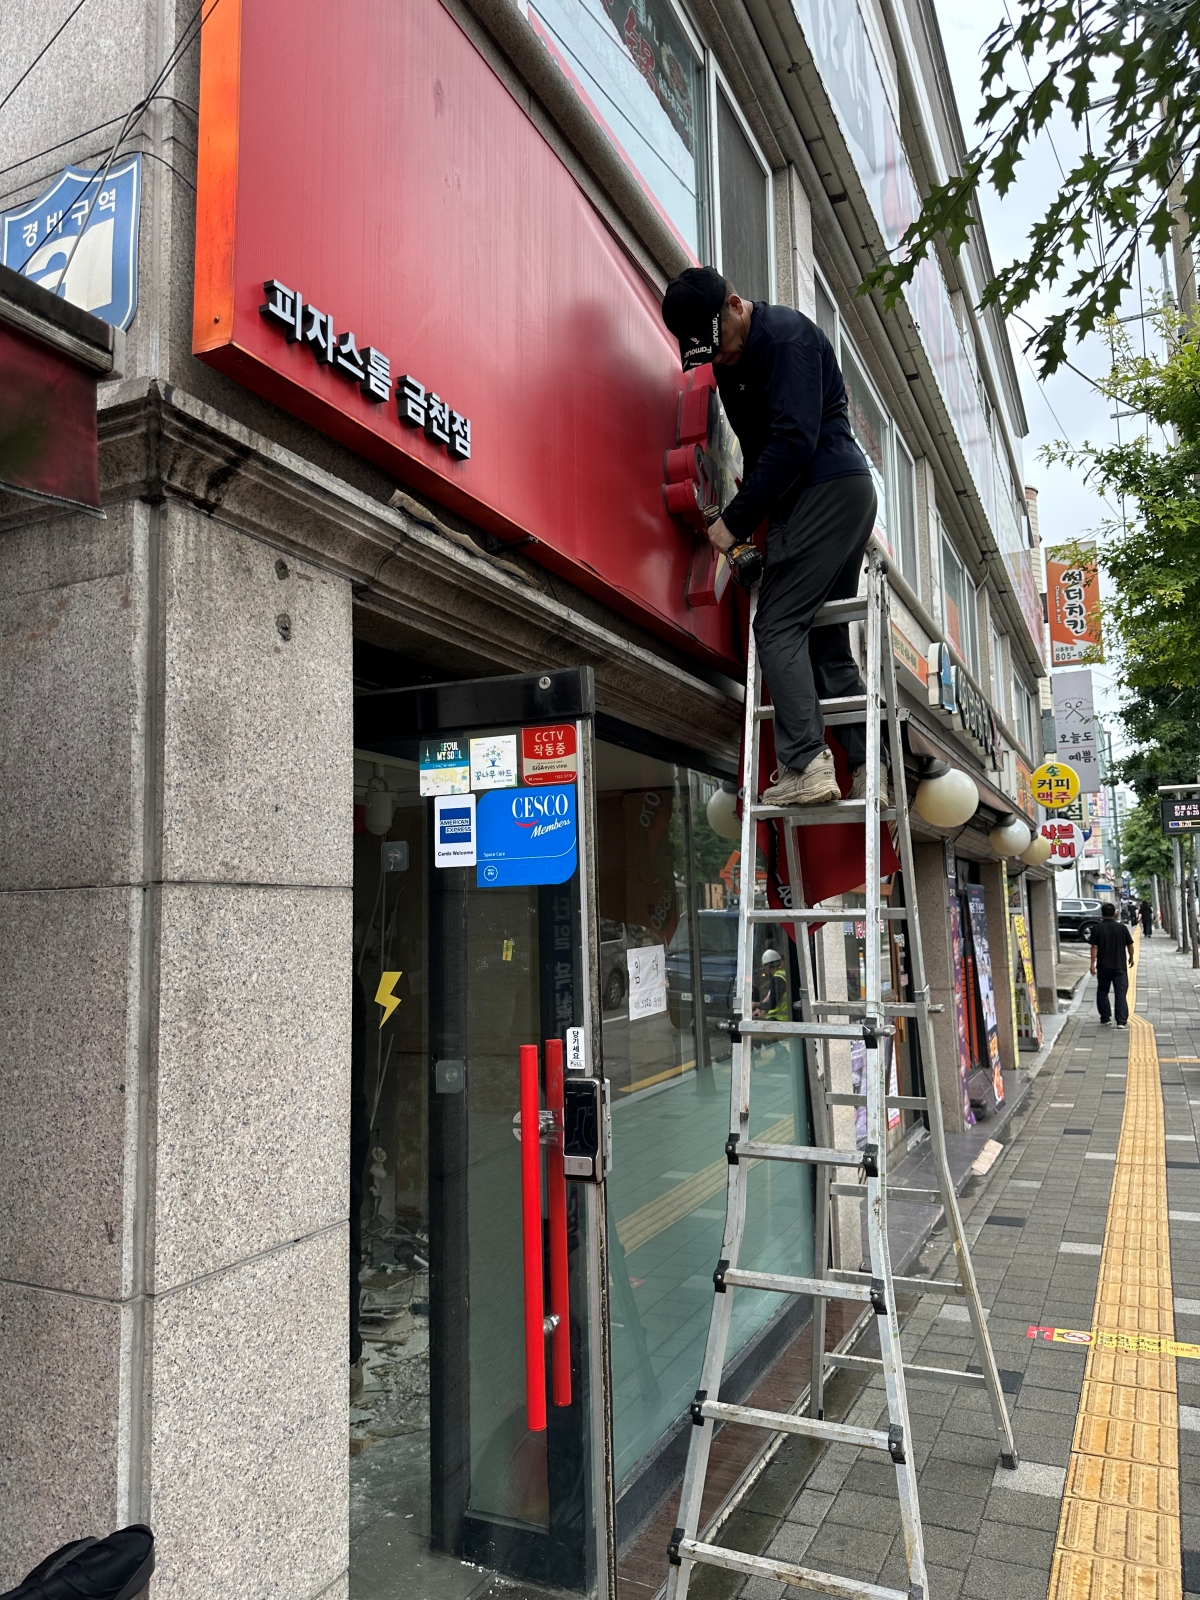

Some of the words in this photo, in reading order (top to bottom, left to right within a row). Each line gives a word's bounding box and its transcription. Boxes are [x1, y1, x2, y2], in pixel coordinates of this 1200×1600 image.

[22, 188, 116, 248] 경비구역
[260, 278, 393, 403] 피자스톰
[396, 373, 471, 461] 금천점
[534, 729, 564, 743] CCTV
[1058, 731, 1094, 744] 오늘도
[446, 749, 463, 760] SOUL
[533, 742, 566, 757] 작동중
[1037, 777, 1070, 791] 커피
[1037, 791, 1072, 804] 맥주
[511, 793, 569, 819] CESCO
[439, 818, 470, 827] AMERICAN
[530, 817, 572, 839] Members
[445, 826, 472, 834] EXPRESS
[1040, 823, 1075, 840] 샤브
[572, 1030, 580, 1060] 당기세요
